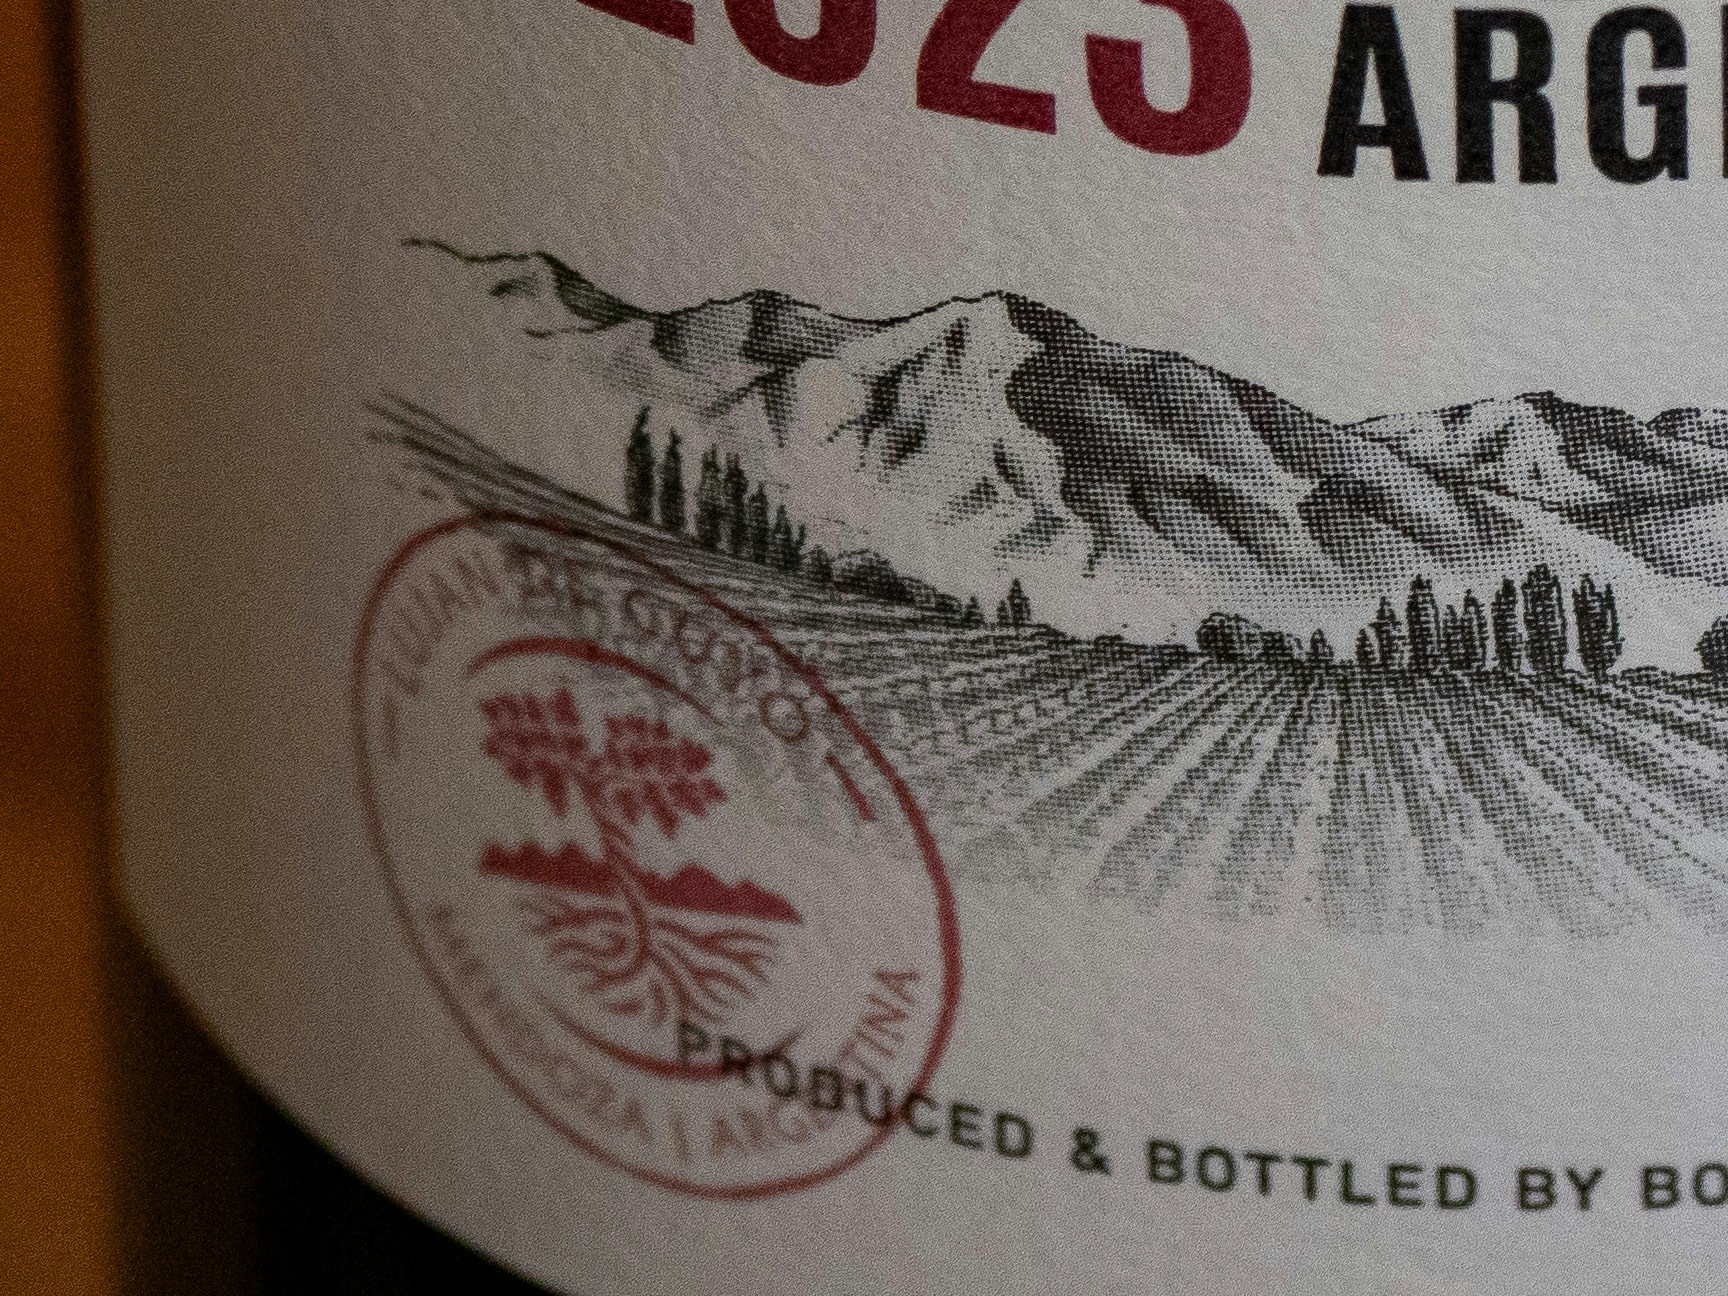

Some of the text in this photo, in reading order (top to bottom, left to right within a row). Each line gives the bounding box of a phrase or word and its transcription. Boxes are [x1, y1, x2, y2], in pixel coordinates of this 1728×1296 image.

[675, 1017, 1036, 1161] PRODUCED
[1068, 1124, 1113, 1177] &
[1143, 1135, 1482, 1212] BOTTLED
[1513, 1164, 1606, 1215] BY
